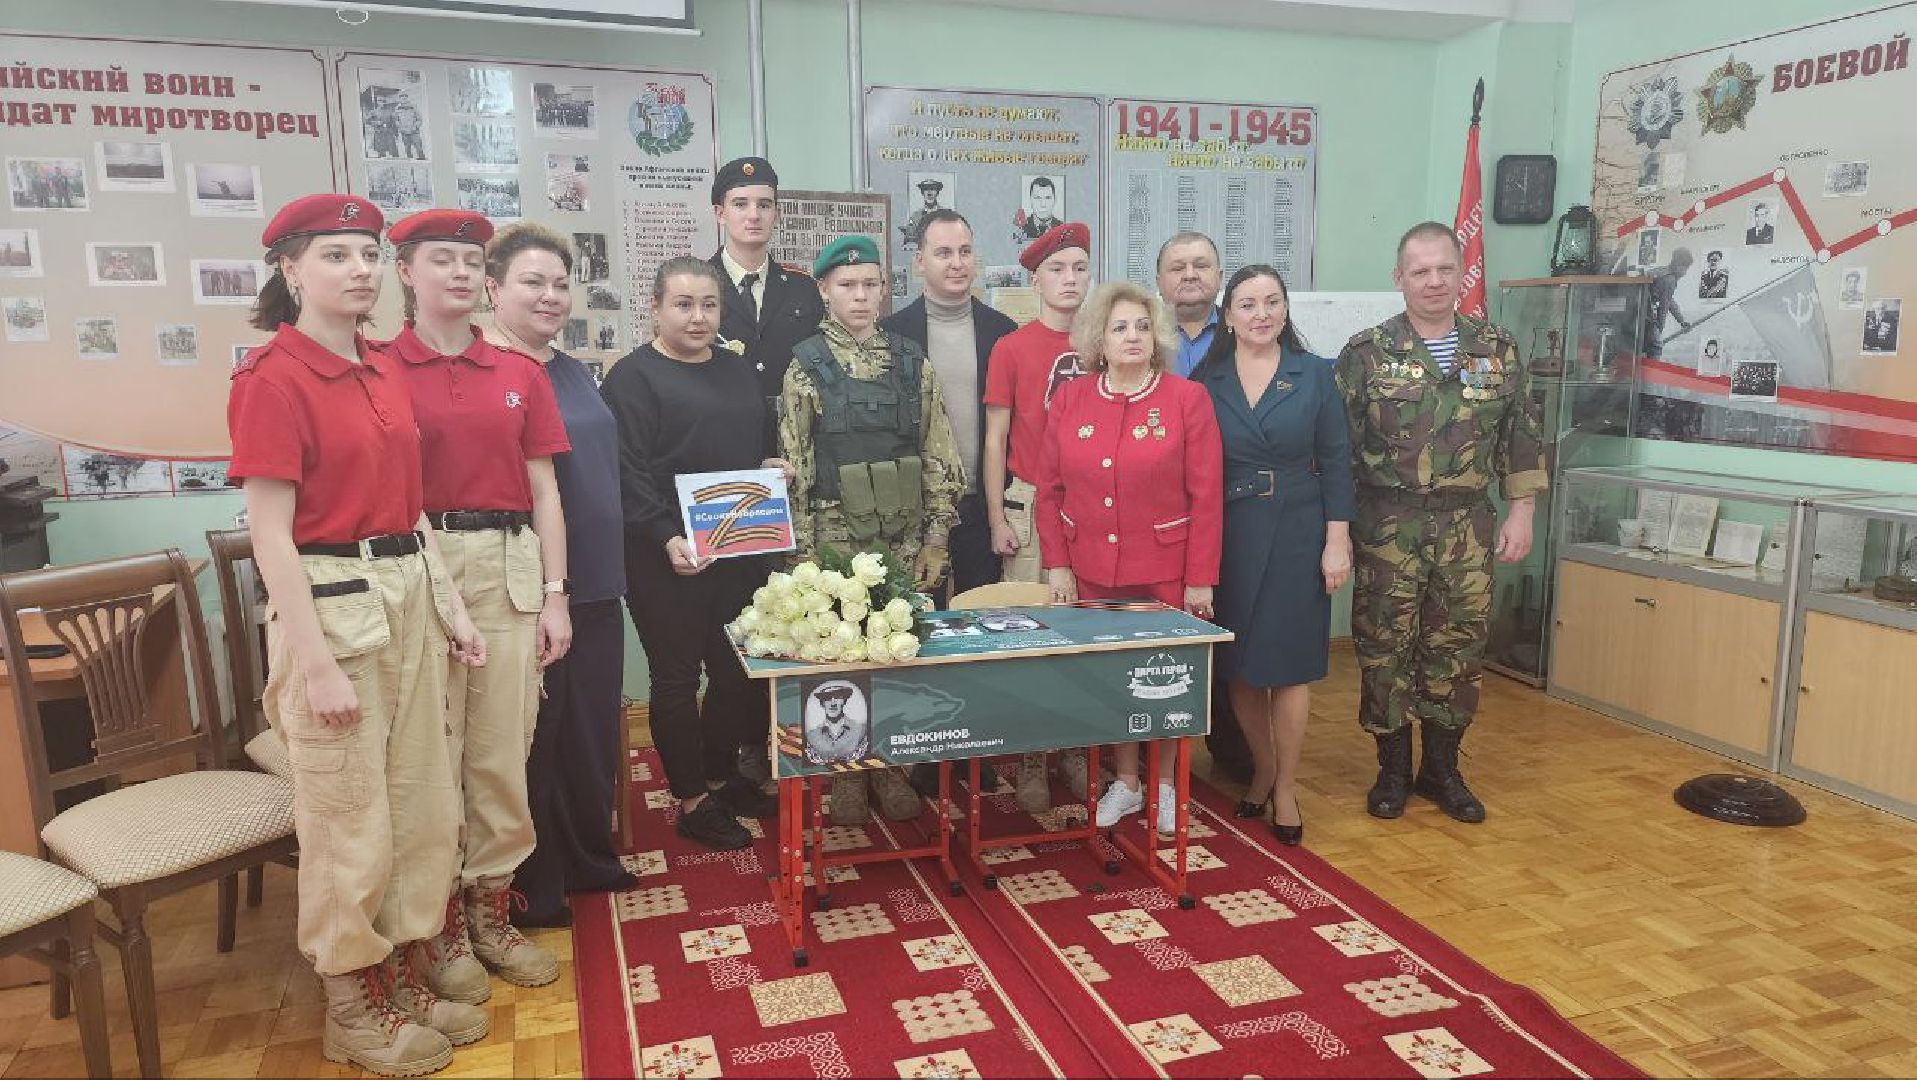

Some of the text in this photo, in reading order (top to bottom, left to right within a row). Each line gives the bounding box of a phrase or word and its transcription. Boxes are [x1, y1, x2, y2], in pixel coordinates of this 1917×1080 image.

[1771, 31, 1911, 93] БОЕВОЙ
[143, 71, 236, 98] воин
[0, 101, 320, 139] дат миротворец
[977, 105, 996, 119] не
[994, 128, 1014, 142] не
[1173, 139, 1194, 152] не
[1222, 156, 1242, 170] не
[890, 728, 970, 746] ЕВДОКИМОВ
[890, 738, 1004, 756] Александр Николаевич
